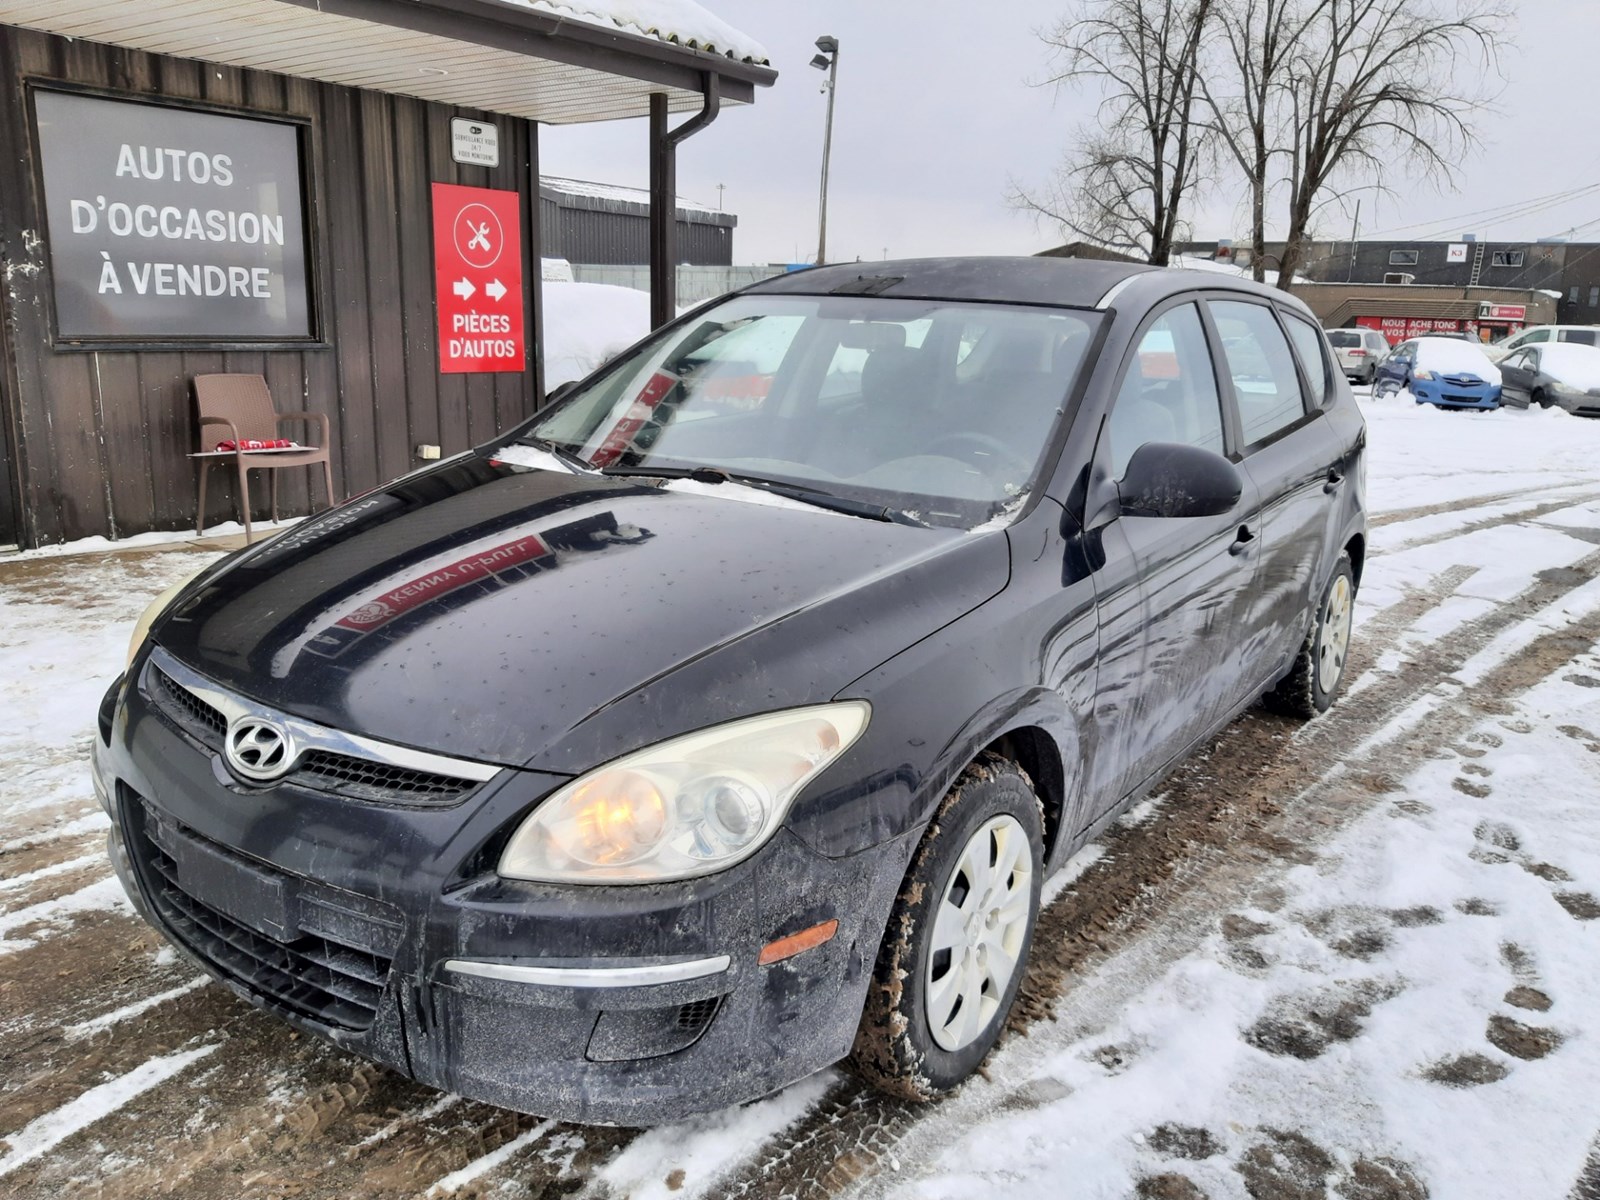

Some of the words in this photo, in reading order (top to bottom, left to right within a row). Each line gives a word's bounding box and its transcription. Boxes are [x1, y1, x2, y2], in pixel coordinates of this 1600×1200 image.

[115, 143, 234, 187] AUTOS
[70, 195, 285, 246] D'OCCASION
[98, 251, 123, 294] À
[127, 262, 271, 298] VENDRE
[453, 309, 510, 333] PIÈCES
[1382, 319, 1406, 327] NOUS
[1386, 329, 1404, 337] VOS
[449, 337, 515, 358] D'AUTOS
